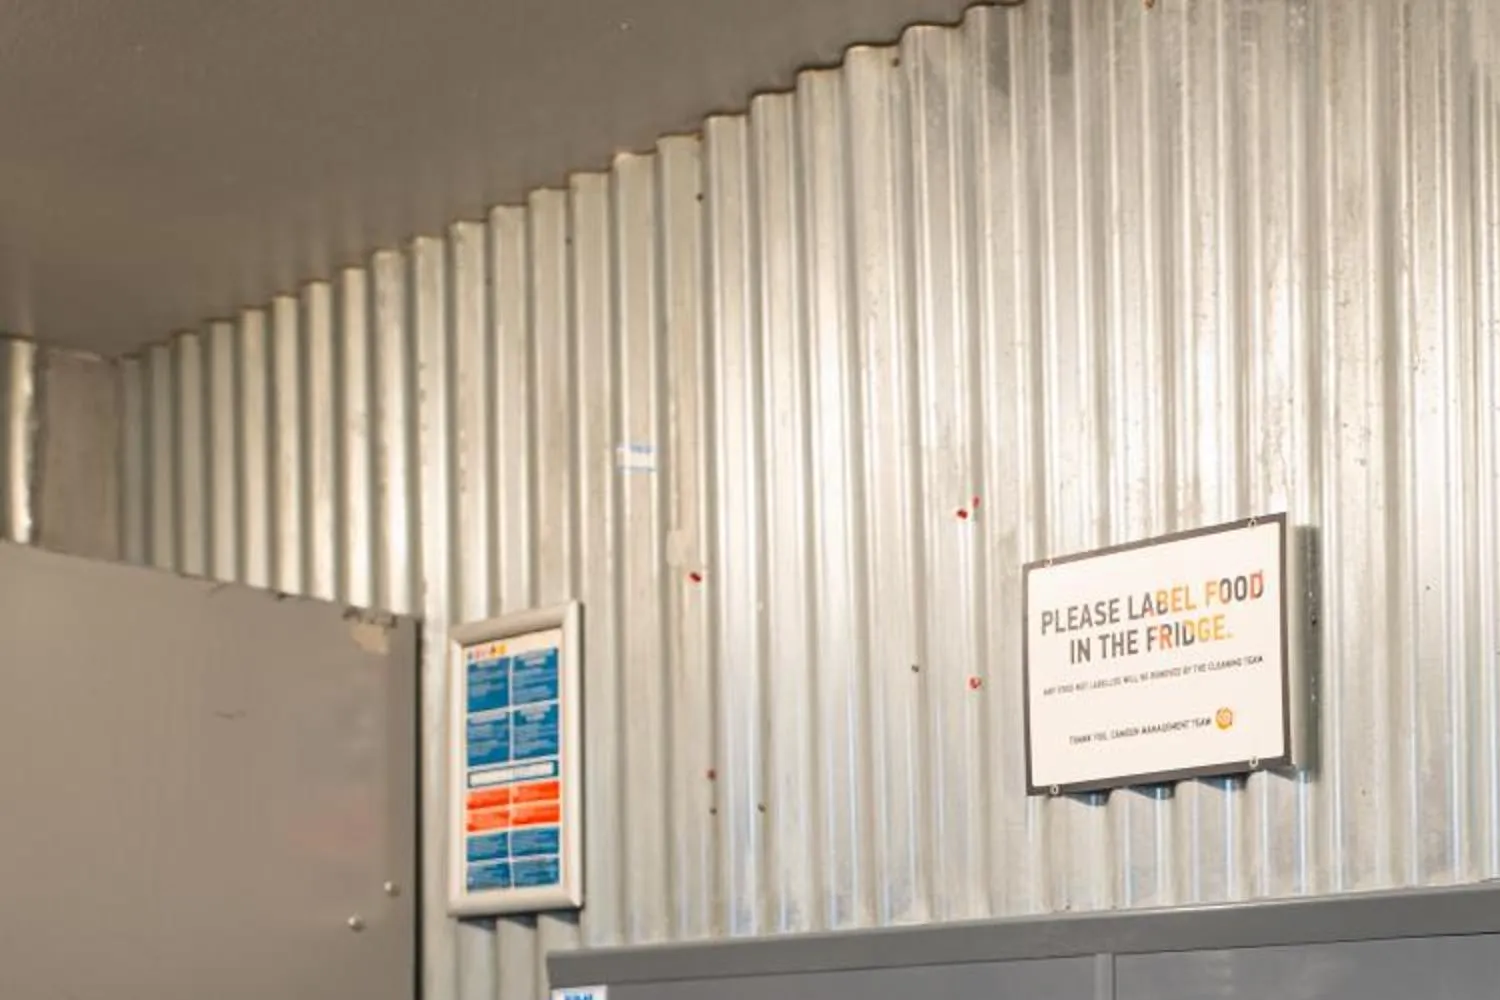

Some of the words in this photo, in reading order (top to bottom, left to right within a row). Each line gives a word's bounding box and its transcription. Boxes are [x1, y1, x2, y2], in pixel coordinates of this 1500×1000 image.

[1041, 597, 1121, 636] PLEASE
[1128, 584, 1197, 621] LABEL
[1205, 570, 1265, 607] FOOD
[1069, 637, 1092, 665] IN
[1099, 629, 1139, 660] THE
[1146, 613, 1234, 653] FRIDGE.
[1243, 654, 1264, 666] TEAM
[1191, 717, 1213, 728] TEAM
